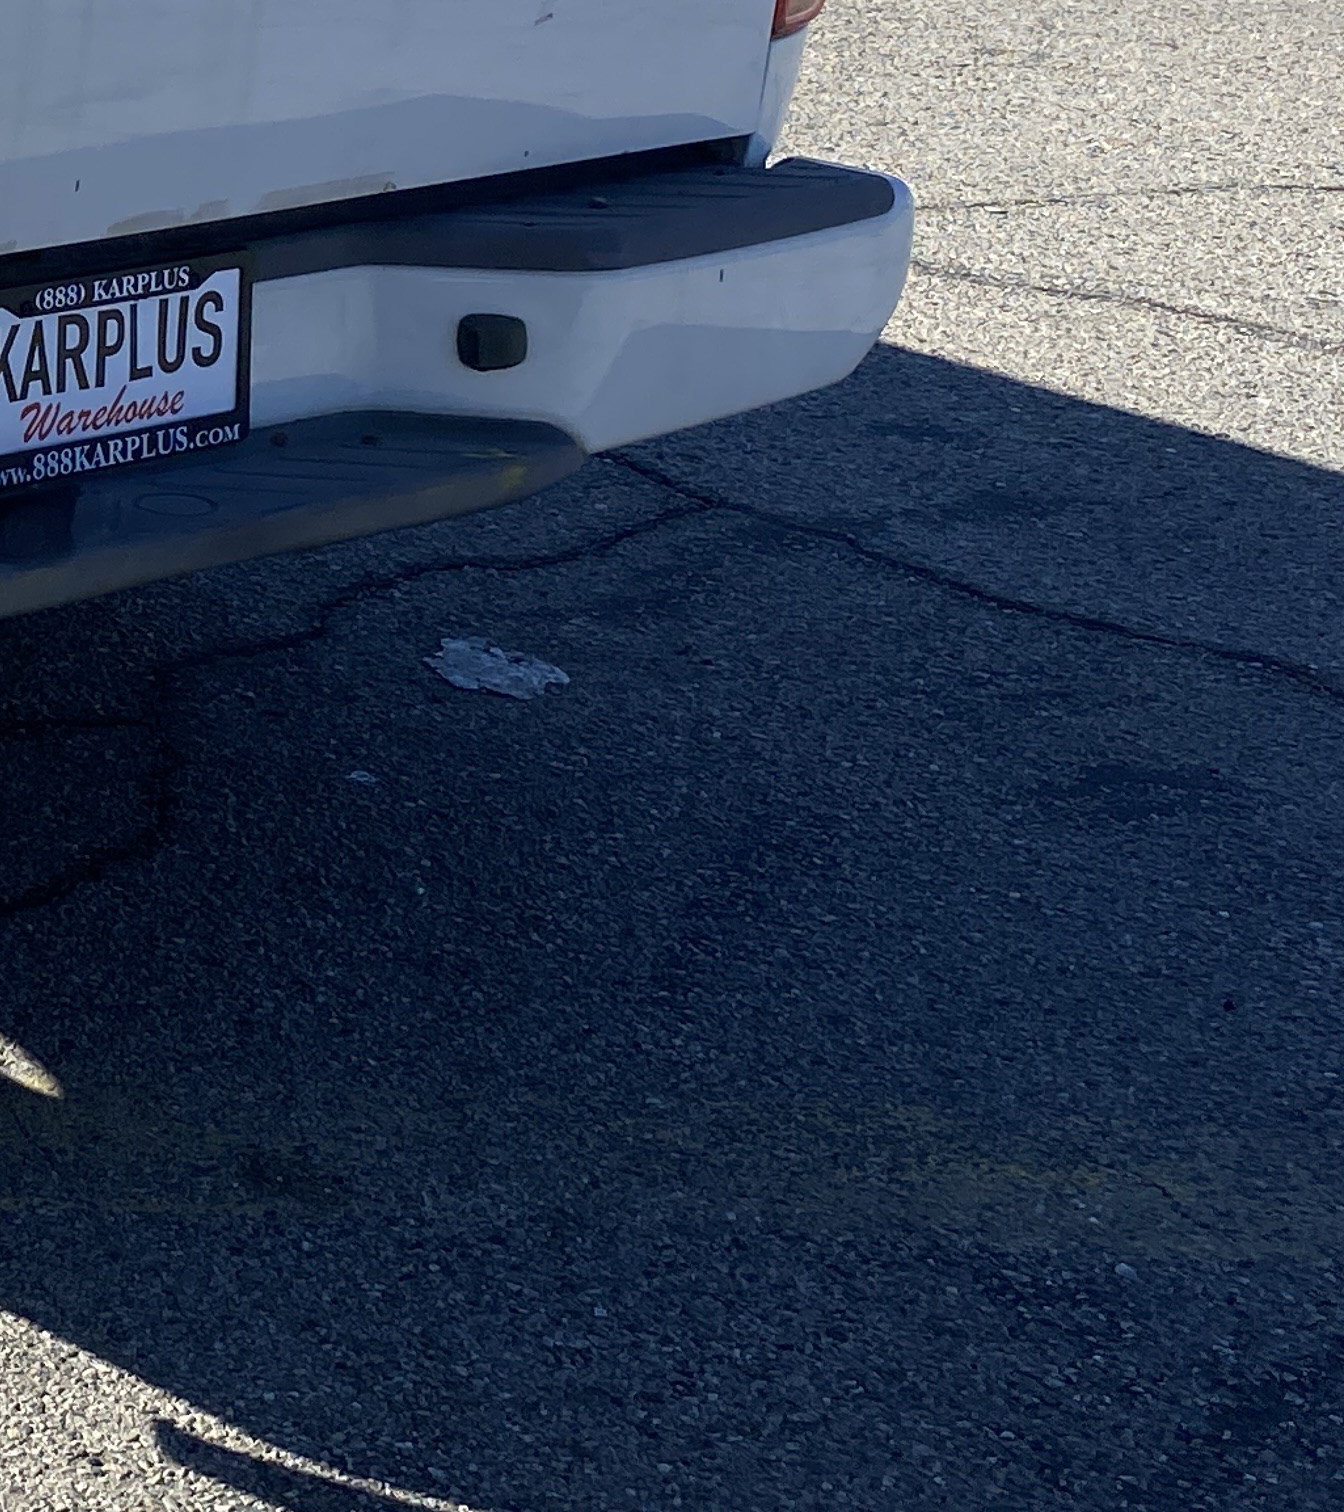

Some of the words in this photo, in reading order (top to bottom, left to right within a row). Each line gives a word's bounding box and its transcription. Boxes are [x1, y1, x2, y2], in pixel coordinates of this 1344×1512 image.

[35, 284, 85, 311] (888)
[92, 266, 190, 301] KARPLUS
[20, 386, 185, 443] Warehouse
